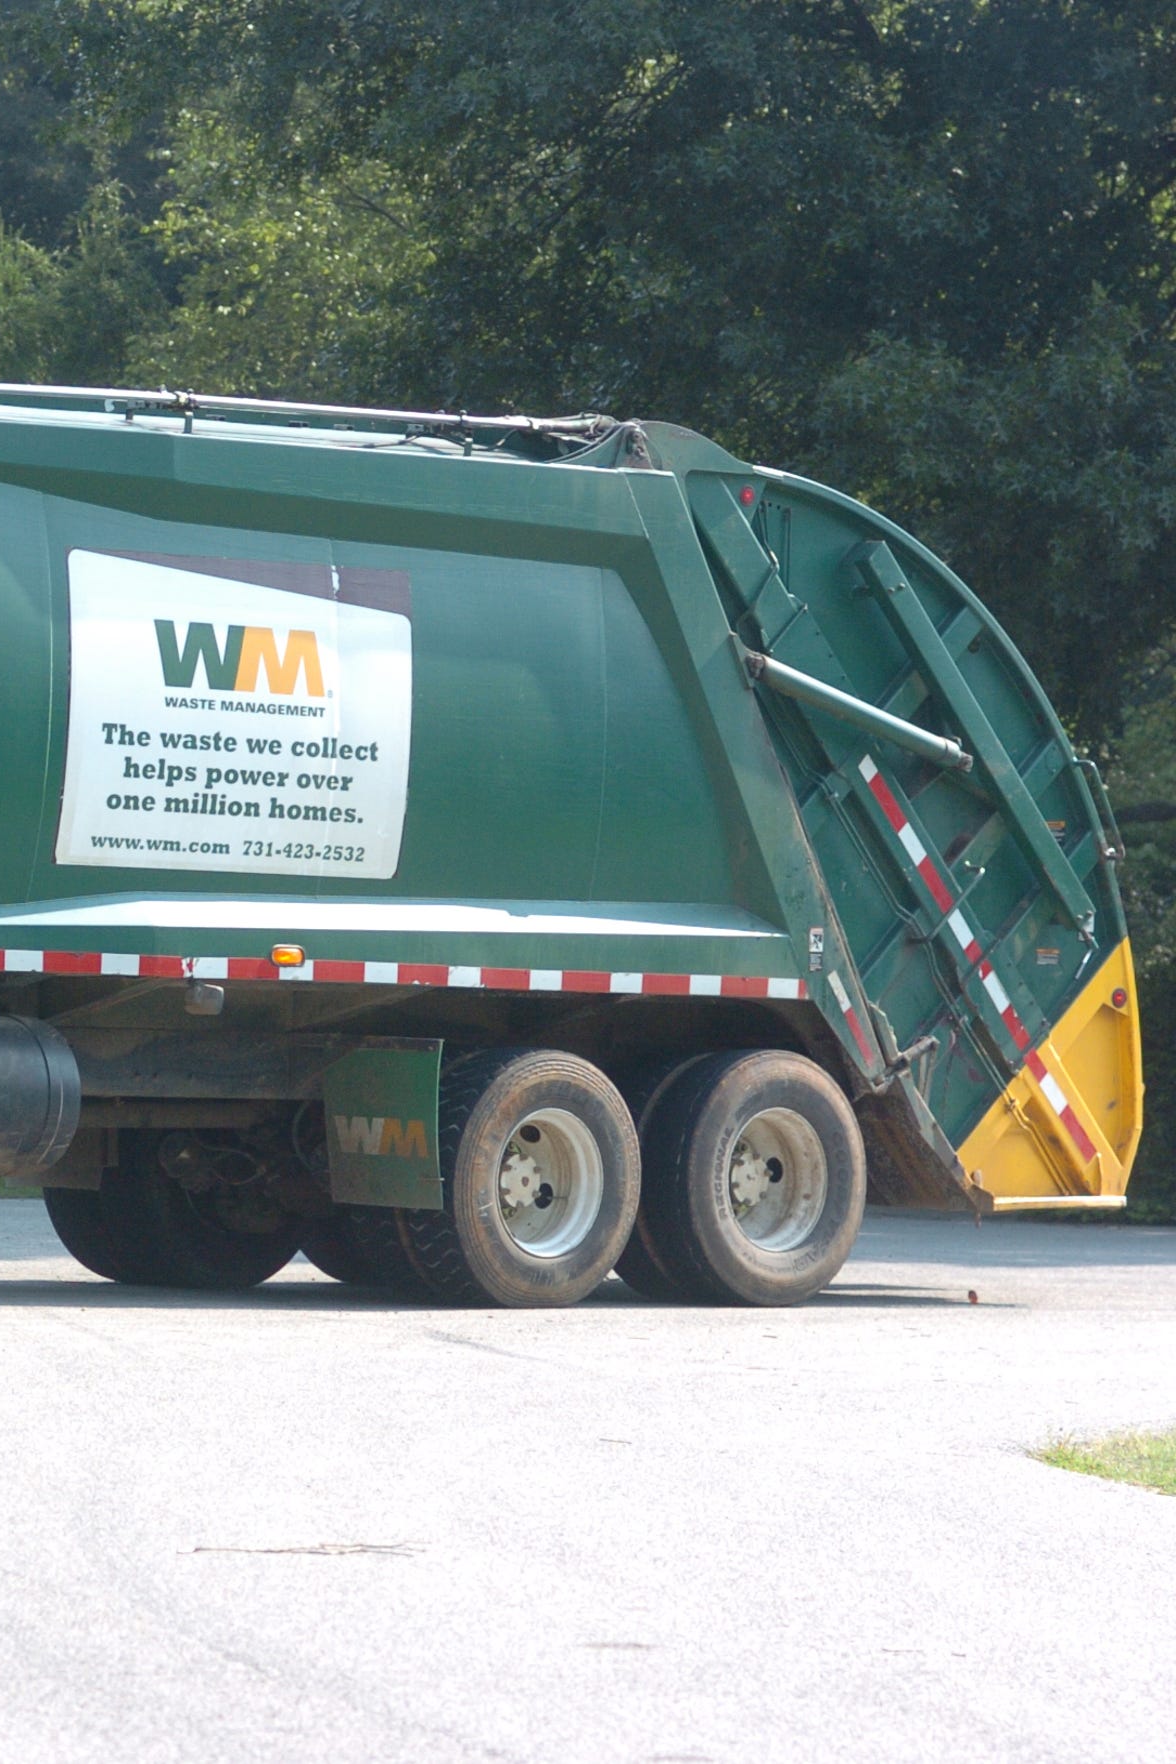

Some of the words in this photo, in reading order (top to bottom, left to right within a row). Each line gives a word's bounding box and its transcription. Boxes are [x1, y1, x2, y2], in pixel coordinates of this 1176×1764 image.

[153, 618, 326, 698] WM
[164, 696, 216, 712] WASTE
[220, 700, 326, 718] MANAGEMENT
[101, 722, 151, 747] The
[160, 731, 238, 752] waste
[246, 738, 283, 755] we
[291, 737, 379, 762] collect
[123, 756, 197, 787] helps
[204, 765, 290, 789] power
[296, 772, 354, 792] over
[106, 793, 156, 812] one
[163, 793, 261, 817] million
[268, 798, 365, 824] homes.
[90, 835, 231, 855] www.wm.com
[242, 840, 366, 862] 731-423-2532
[333, 1115, 429, 1158] WM
